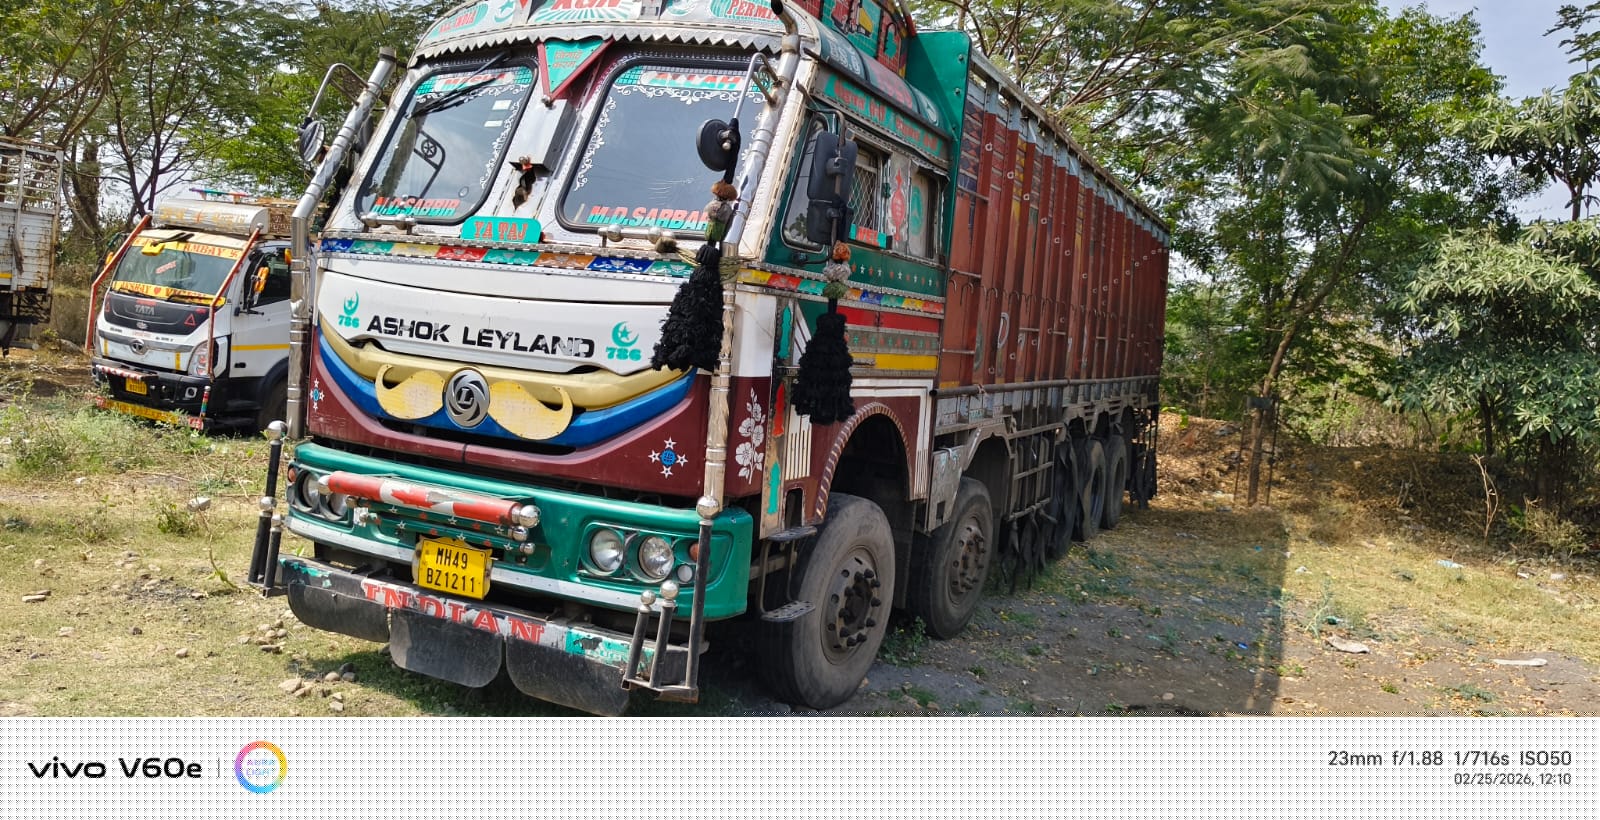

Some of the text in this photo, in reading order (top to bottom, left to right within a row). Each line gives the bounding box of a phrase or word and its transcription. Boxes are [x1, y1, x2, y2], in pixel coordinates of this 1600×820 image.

[726, 0, 780, 20] PERMI
[648, 73, 742, 90] ALLAH
[474, 220, 528, 241] YA TAJ
[135, 304, 155, 316] TATA
[338, 314, 360, 329] 786
[366, 314, 595, 359] ASHOK LEYLAND
[605, 346, 642, 362] 786
[435, 547, 468, 569] MH49
[426, 567, 475, 593] BZ1211
[362, 581, 545, 645] INDIAN
